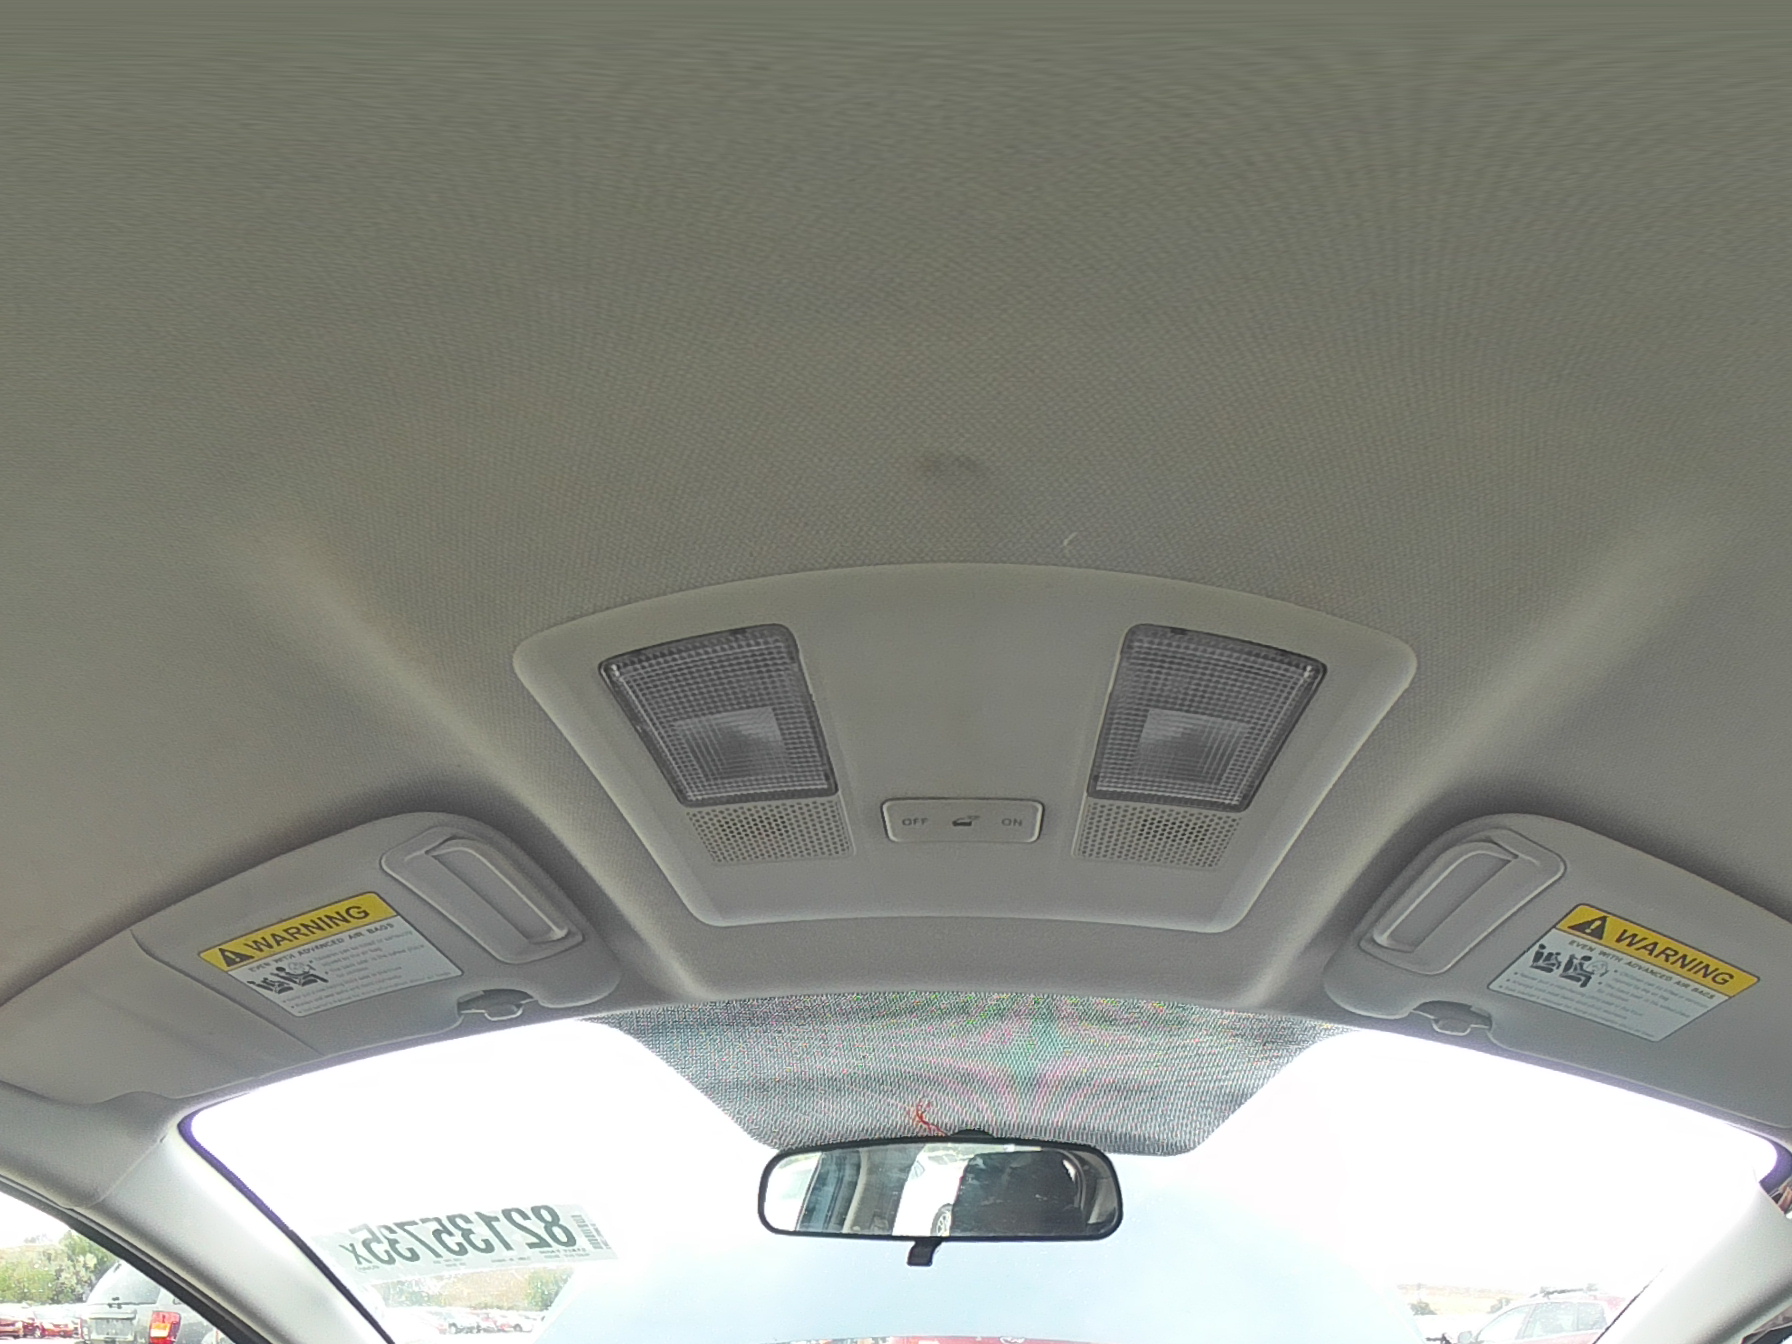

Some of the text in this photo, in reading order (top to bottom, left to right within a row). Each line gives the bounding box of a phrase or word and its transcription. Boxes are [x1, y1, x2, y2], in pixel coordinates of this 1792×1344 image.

[901, 817, 1023, 827] OFF ON
[243, 904, 370, 953] WARNING
[1567, 939, 1596, 953] EVEN
[1624, 960, 1674, 984] ADVANCED
[1614, 928, 1734, 987] WARNING
